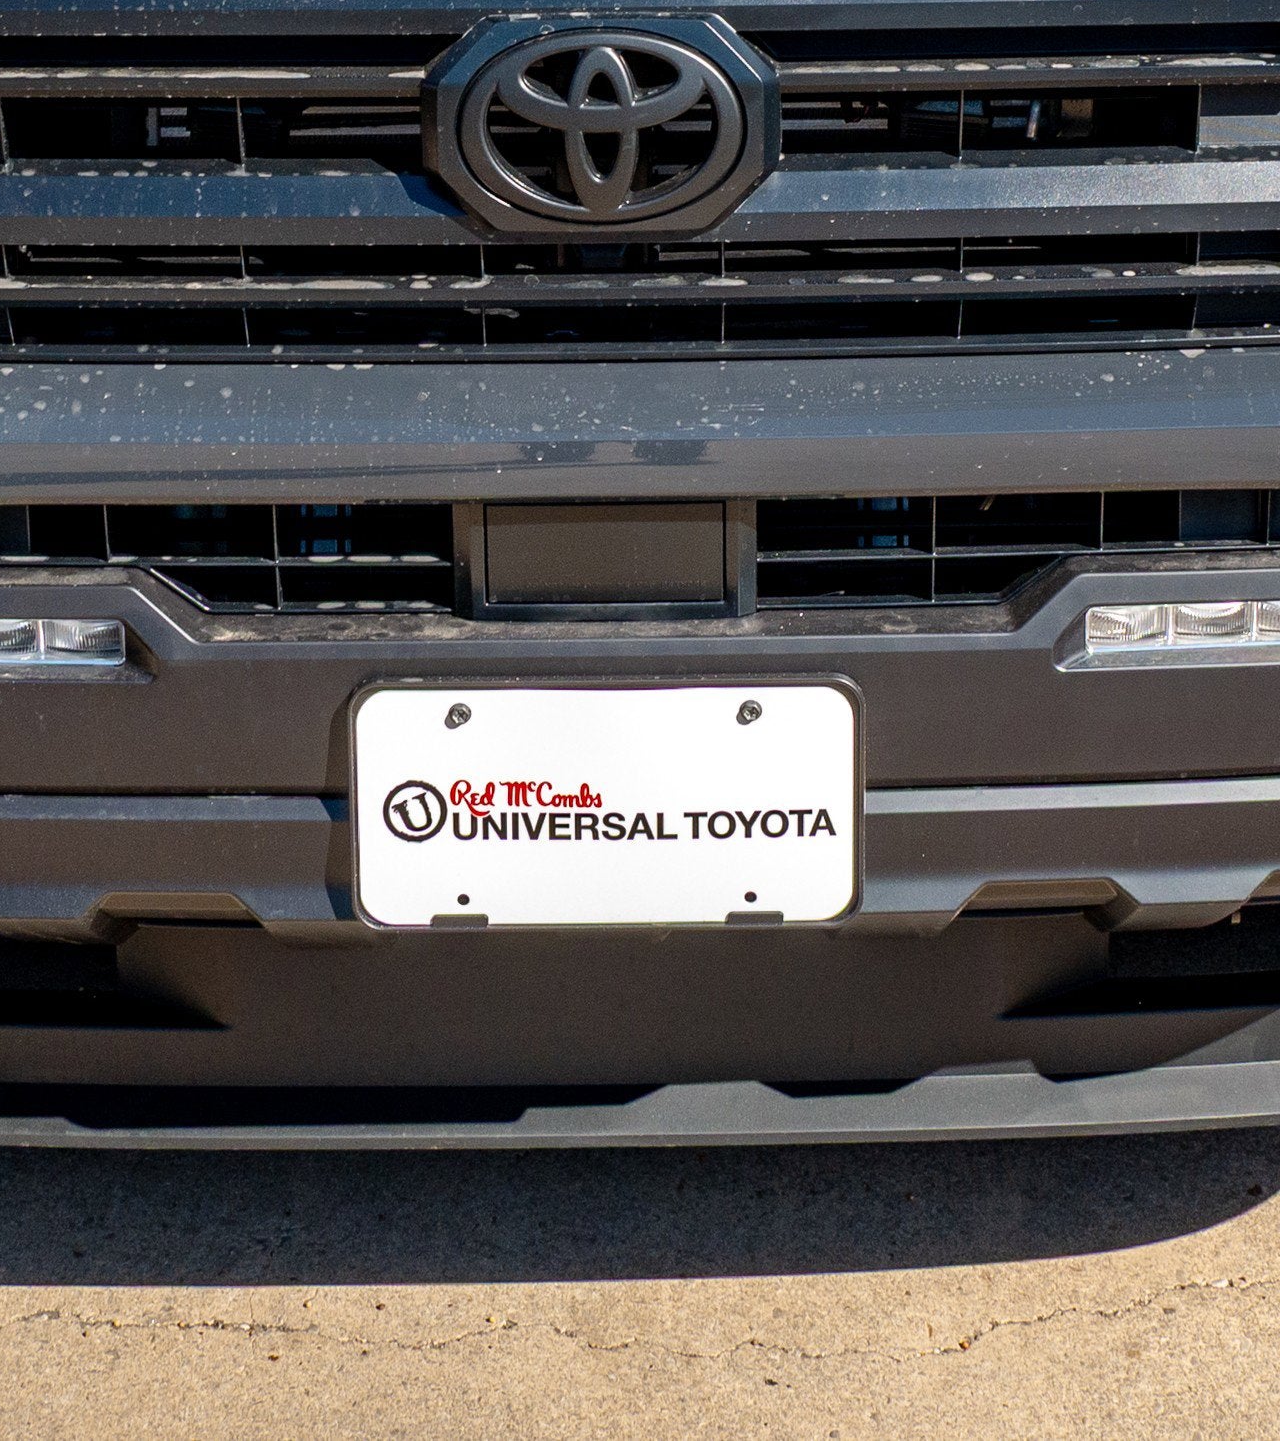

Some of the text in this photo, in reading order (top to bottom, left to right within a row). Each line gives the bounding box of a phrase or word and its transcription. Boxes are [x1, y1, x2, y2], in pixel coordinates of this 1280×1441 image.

[450, 779, 603, 816] Red McCombs
[452, 808, 837, 841] UNIVERSAL TOYOTA
